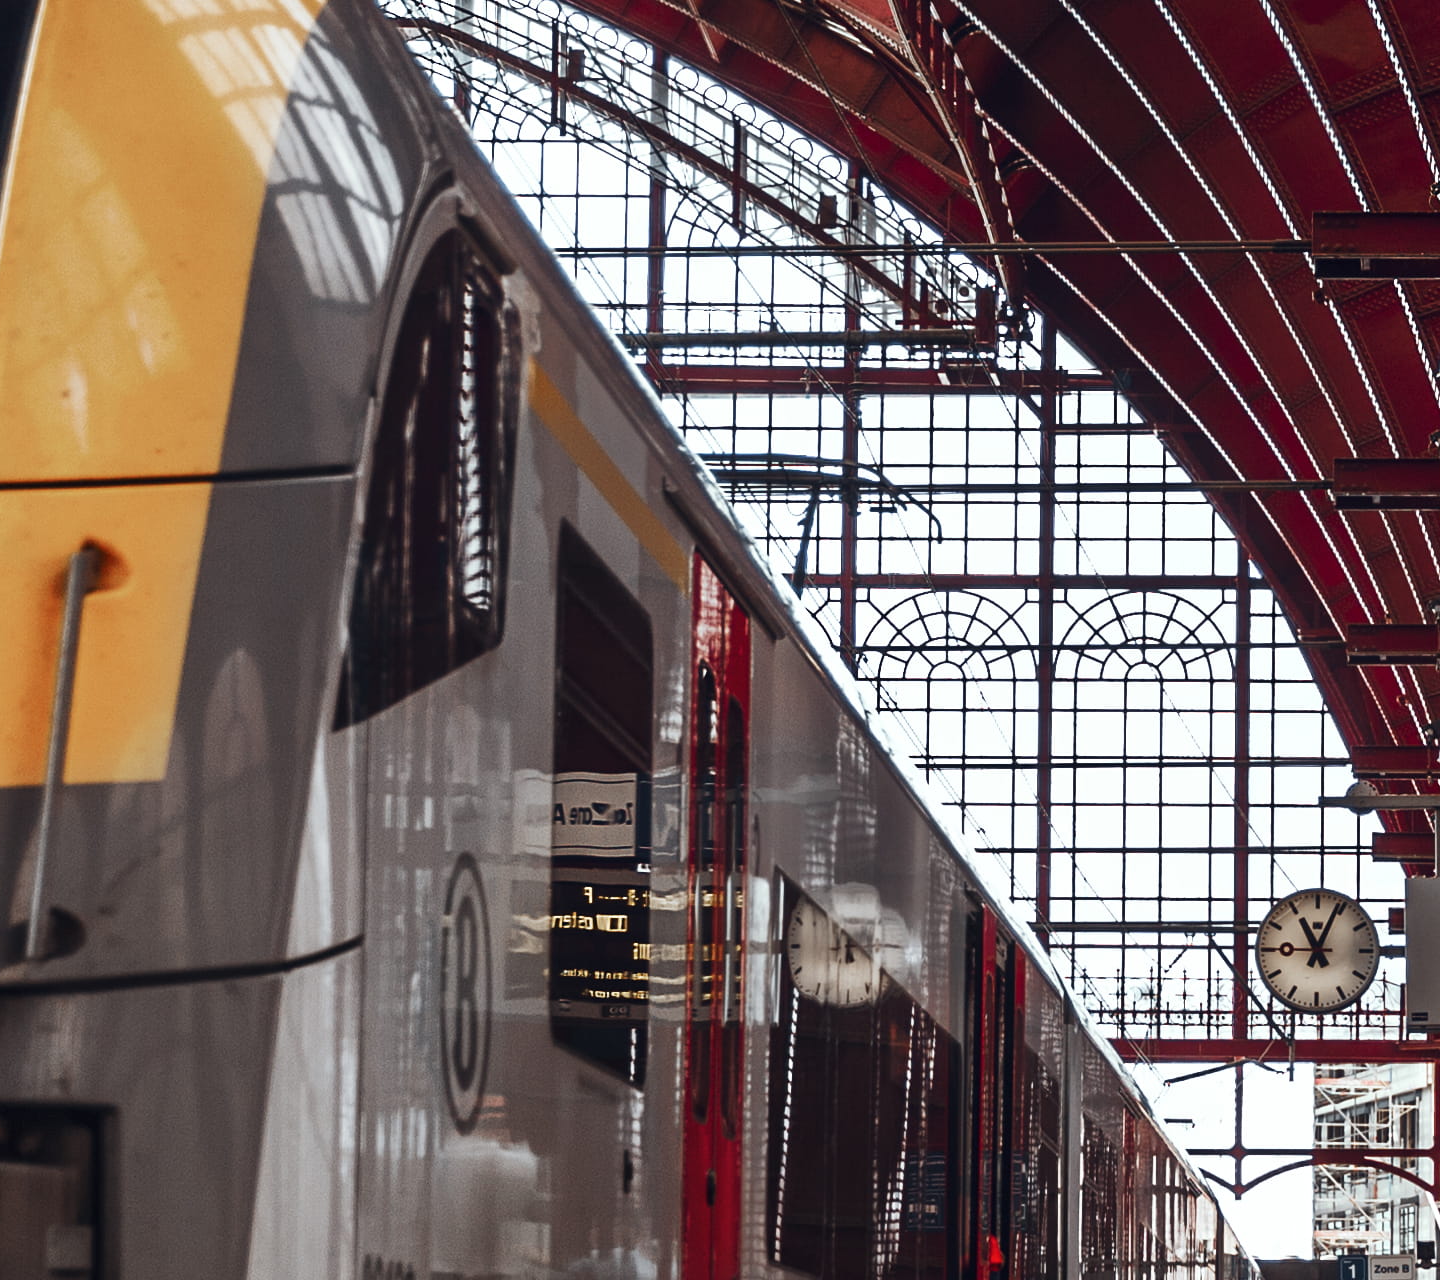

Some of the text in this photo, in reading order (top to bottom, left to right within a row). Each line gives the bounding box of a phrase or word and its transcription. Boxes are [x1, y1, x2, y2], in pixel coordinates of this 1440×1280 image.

[1348, 1263, 1356, 1279] 1
[1373, 1264, 1410, 1274] Zone B
